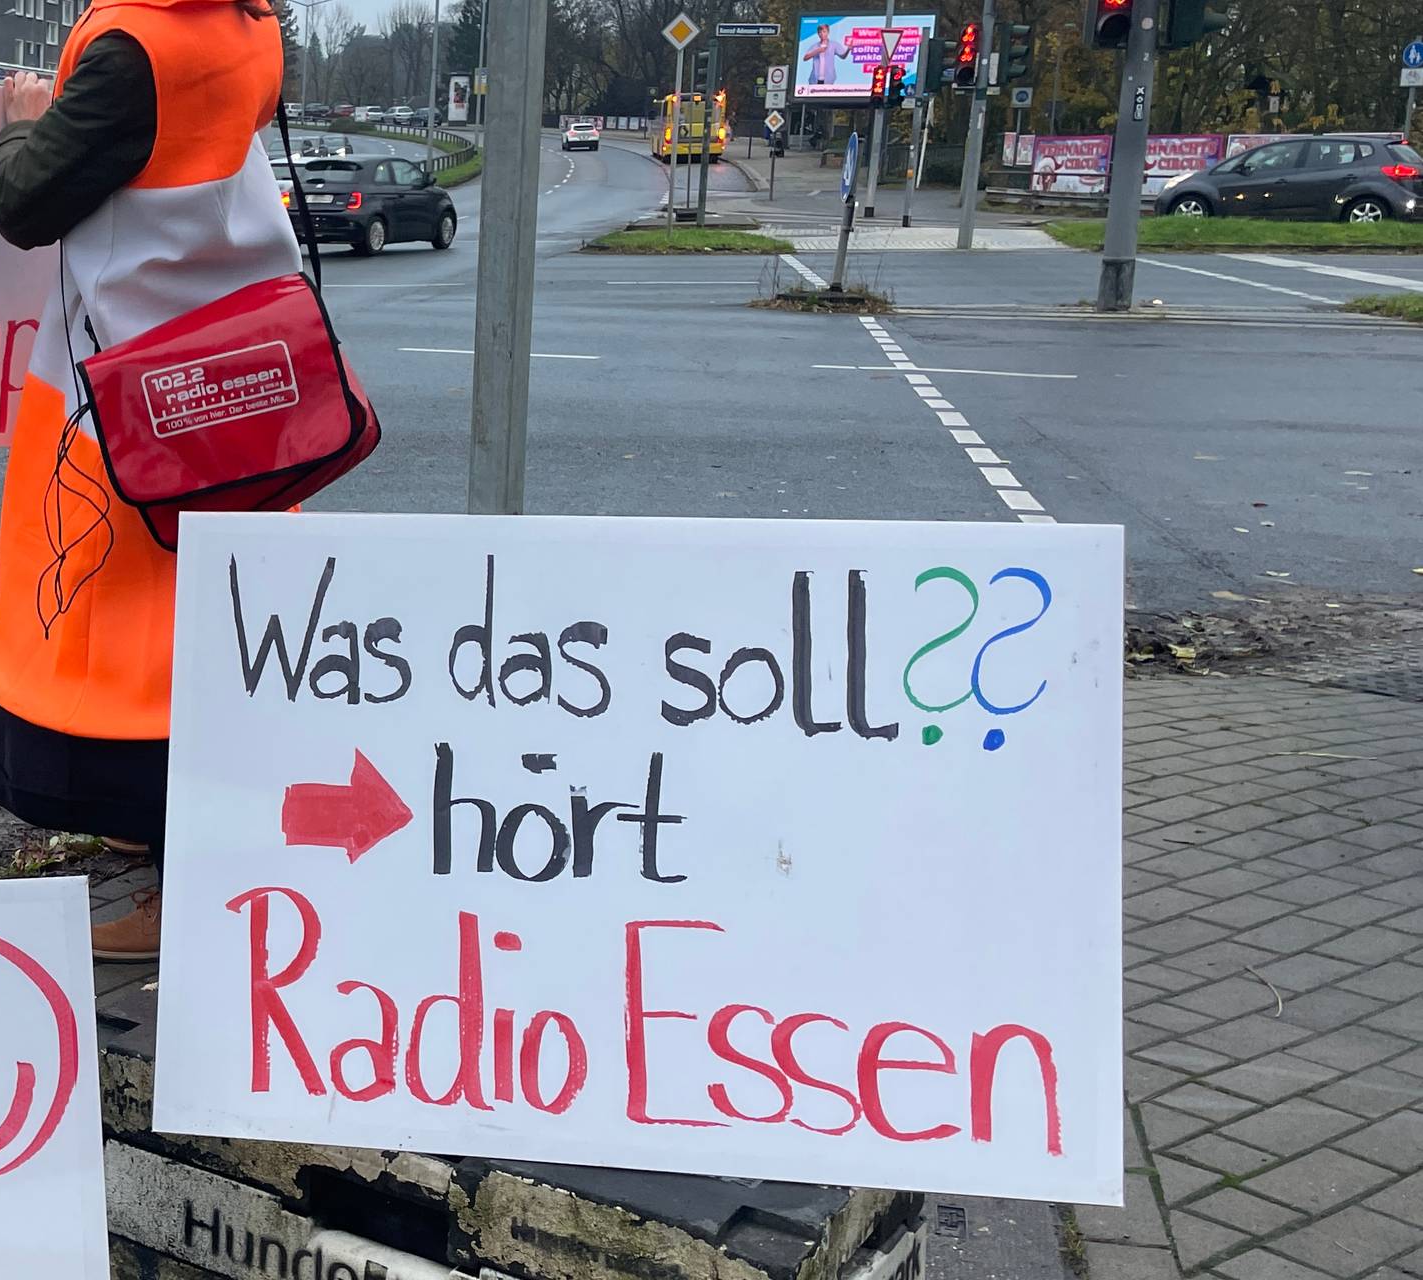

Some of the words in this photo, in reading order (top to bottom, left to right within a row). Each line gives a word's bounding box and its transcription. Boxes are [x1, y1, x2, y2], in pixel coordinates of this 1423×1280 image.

[151, 367, 205, 392] 102.2
[166, 382, 218, 405] radio
[222, 367, 282, 390] essen
[194, 414, 209, 423] von
[209, 410, 227, 421] hier.
[230, 554, 411, 704] Was
[449, 555, 610, 717] das
[434, 743, 687, 883] hört
[226, 888, 587, 1115] Radio
[626, 921, 1061, 1156] Essen
